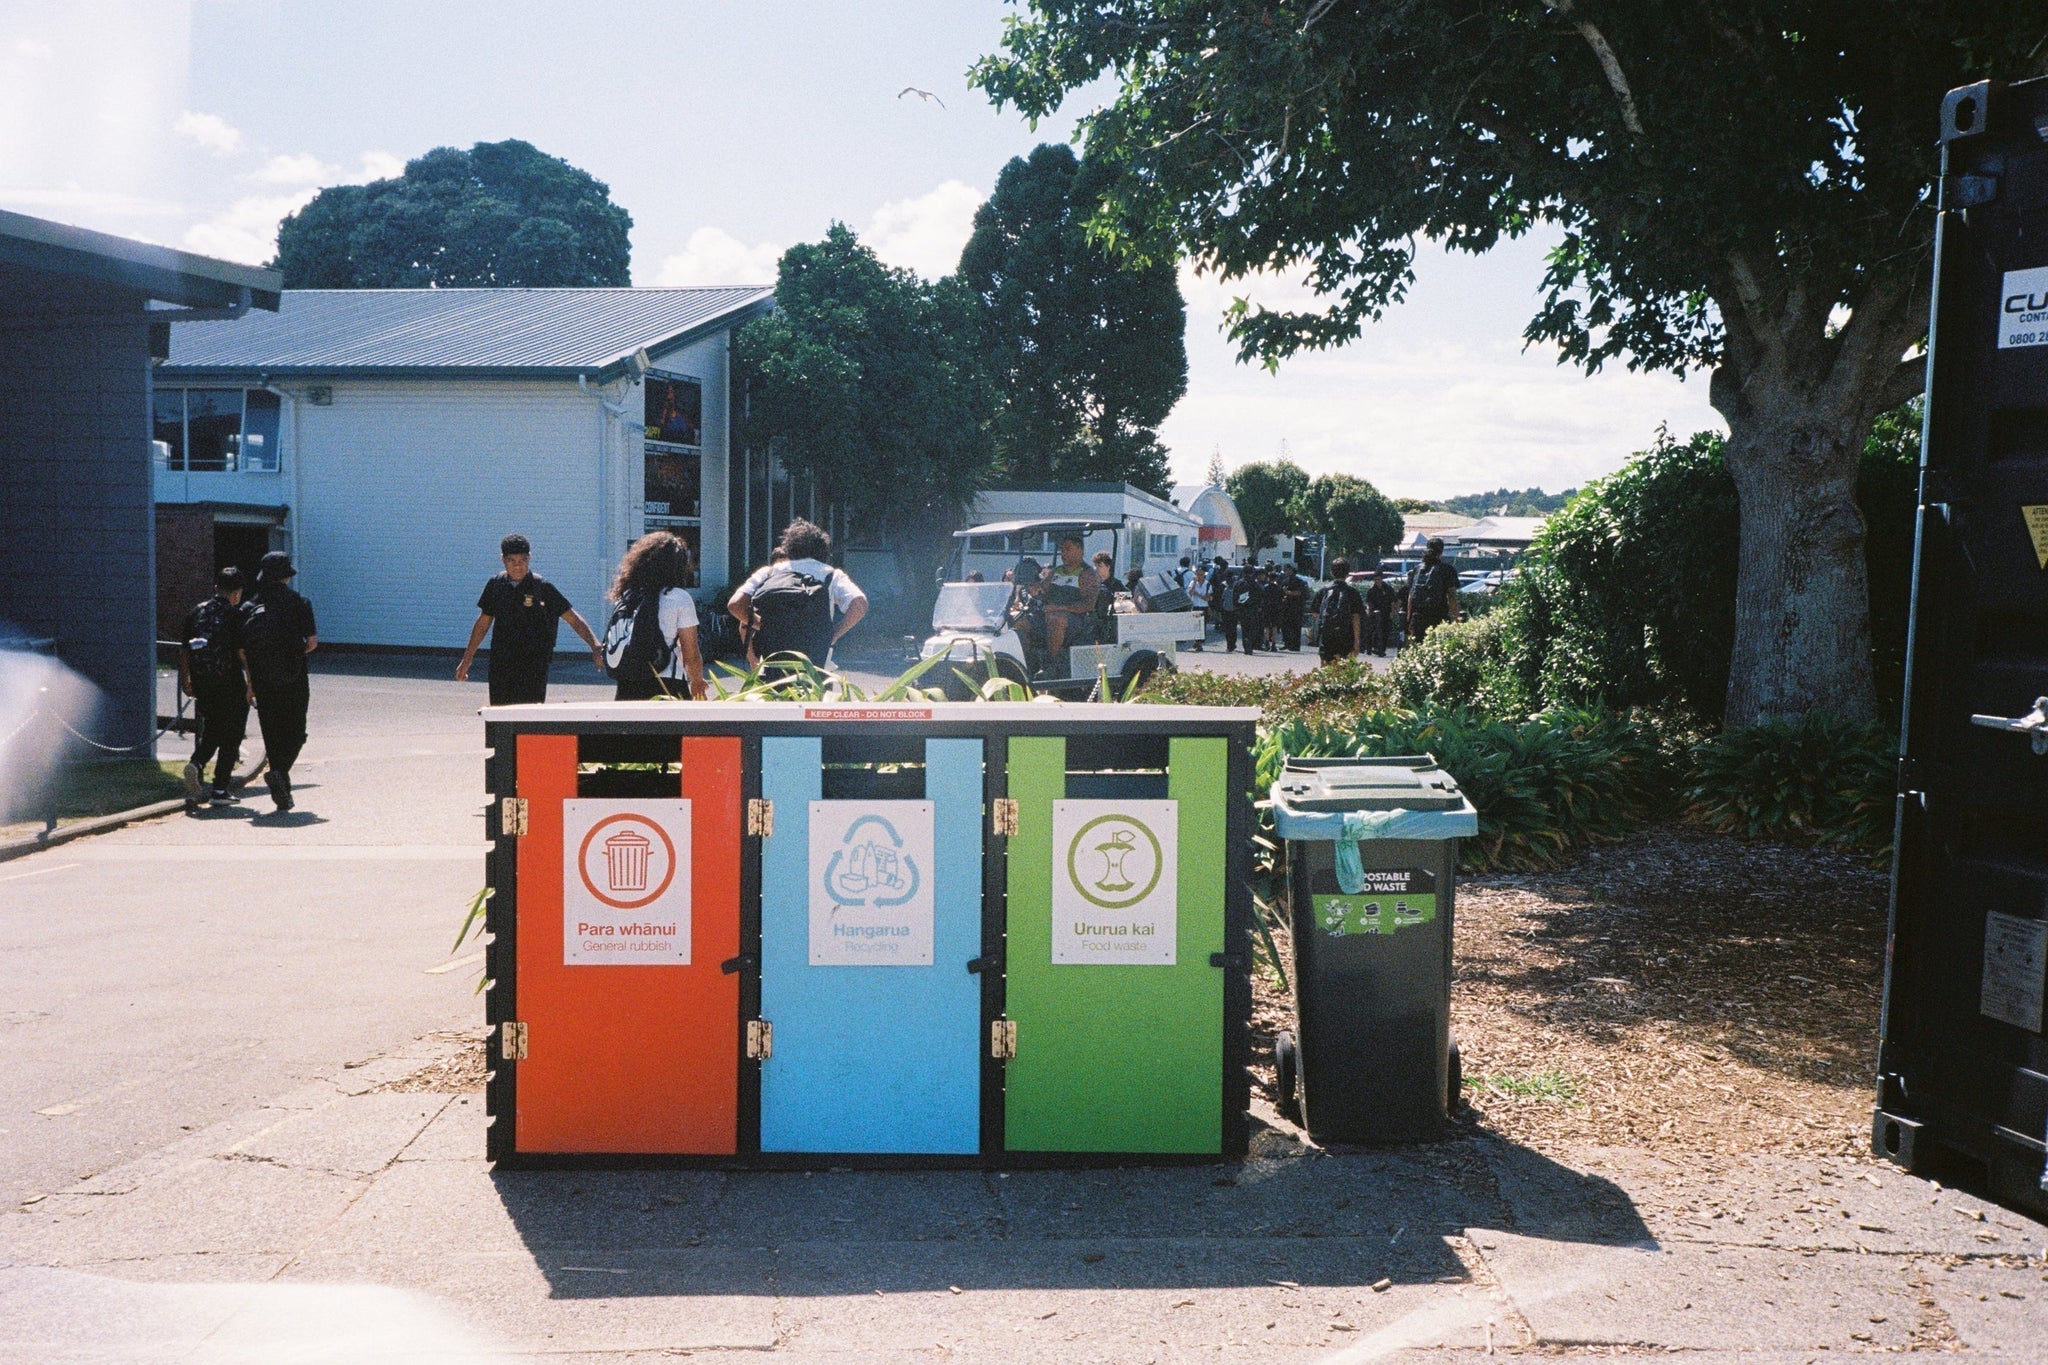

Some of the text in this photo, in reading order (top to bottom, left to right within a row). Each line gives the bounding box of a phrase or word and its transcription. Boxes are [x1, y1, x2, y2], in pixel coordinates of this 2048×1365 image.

[2009, 332, 2036, 345] 0800
[810, 710, 832, 718] KEEP
[833, 710, 859, 719] CLEAR
[867, 710, 878, 719] DO
[881, 710, 897, 719] NOT
[899, 710, 926, 719] BLOCK
[1373, 882, 1407, 891] WASTE
[578, 922, 676, 936] Para whānui
[833, 923, 911, 939] Hangarua
[1074, 922, 1155, 936] Ururua kai
[583, 940, 672, 952] General rubbish
[1081, 940, 1148, 951] Food waste
